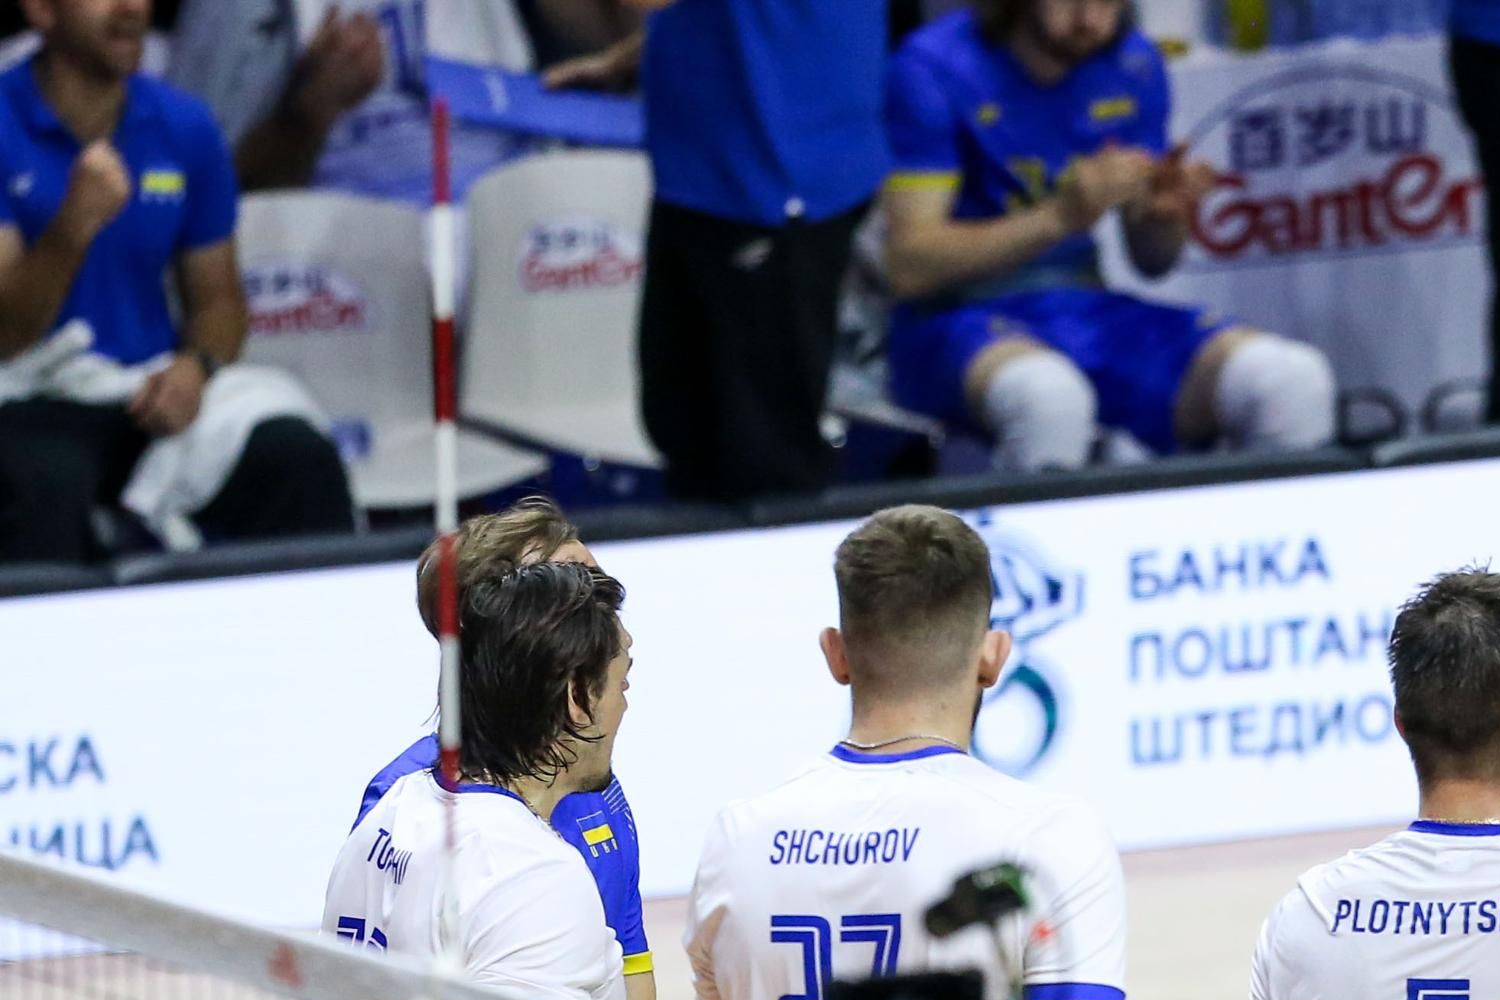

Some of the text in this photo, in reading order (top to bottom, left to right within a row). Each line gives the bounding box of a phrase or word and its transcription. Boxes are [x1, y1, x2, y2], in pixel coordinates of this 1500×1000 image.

[1129, 538, 1331, 601] БАНКА
[1129, 610, 1391, 682] ПОШТАН
[1130, 698, 1393, 767] ШТЕДИО
[769, 827, 920, 866] SHCHUROV
